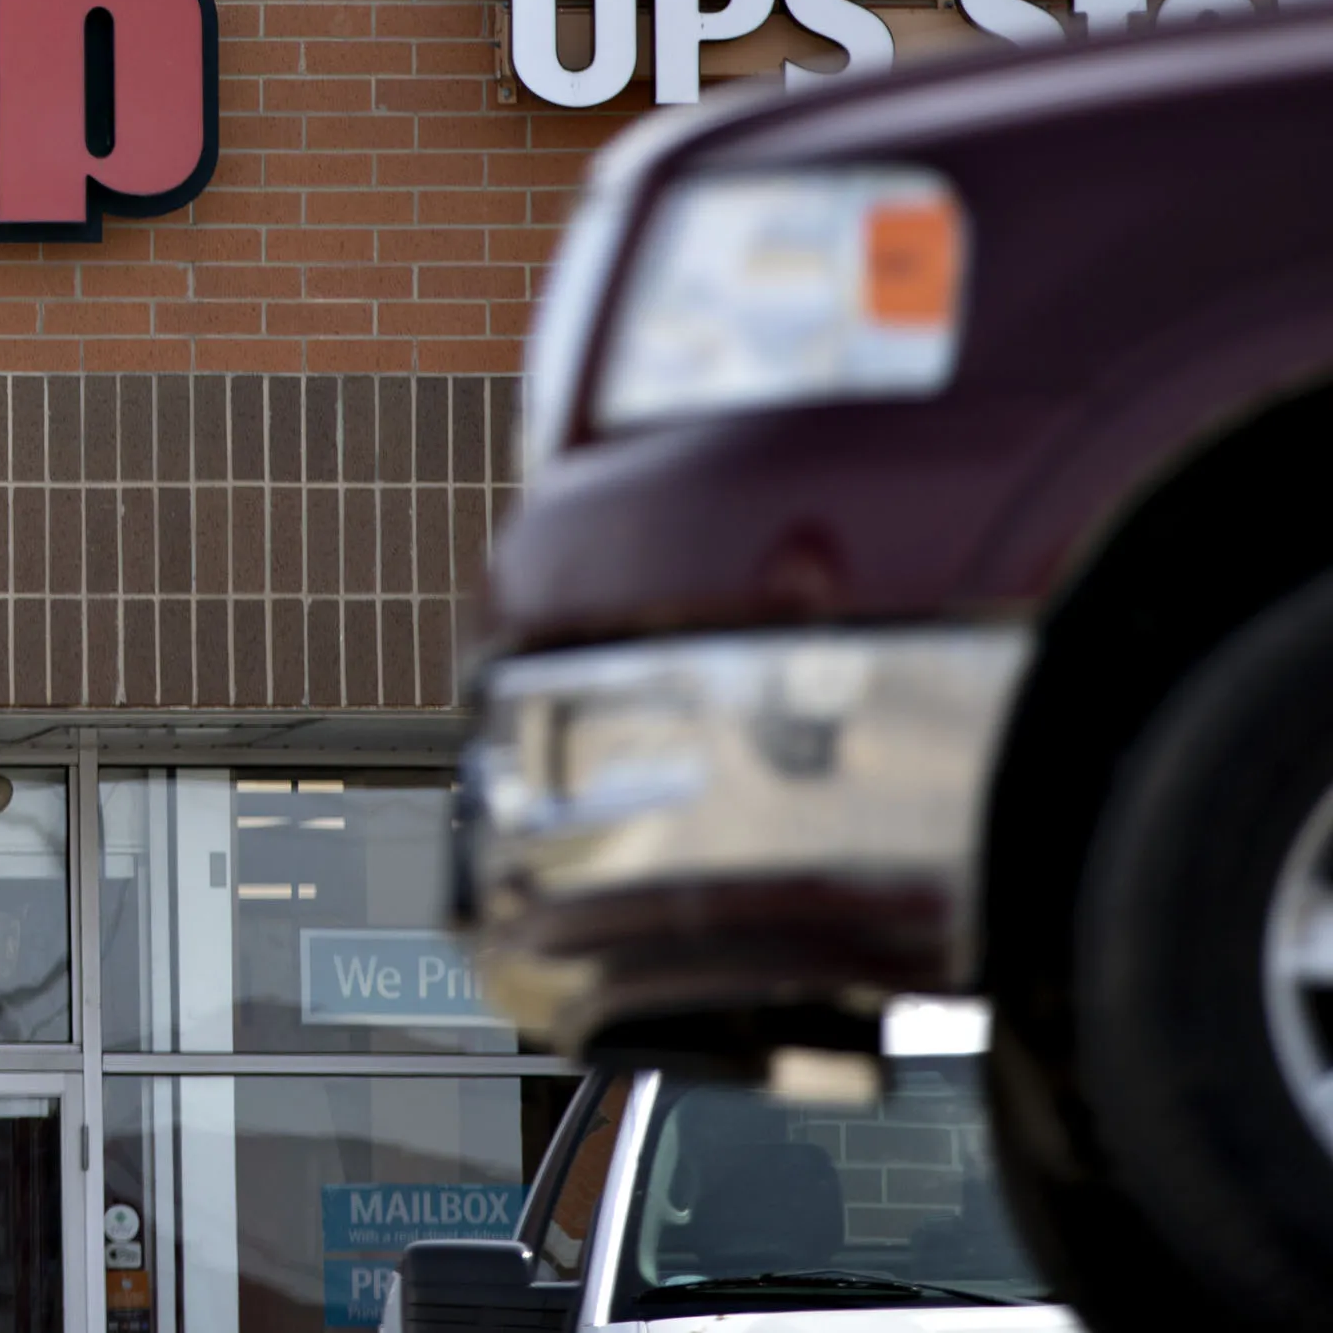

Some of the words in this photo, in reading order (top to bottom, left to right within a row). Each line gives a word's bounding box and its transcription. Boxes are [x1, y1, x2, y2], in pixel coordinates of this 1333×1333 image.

[333, 955, 402, 999] We
[350, 1191, 510, 1225] MAILBOX
[348, 1227, 380, 1243] With
